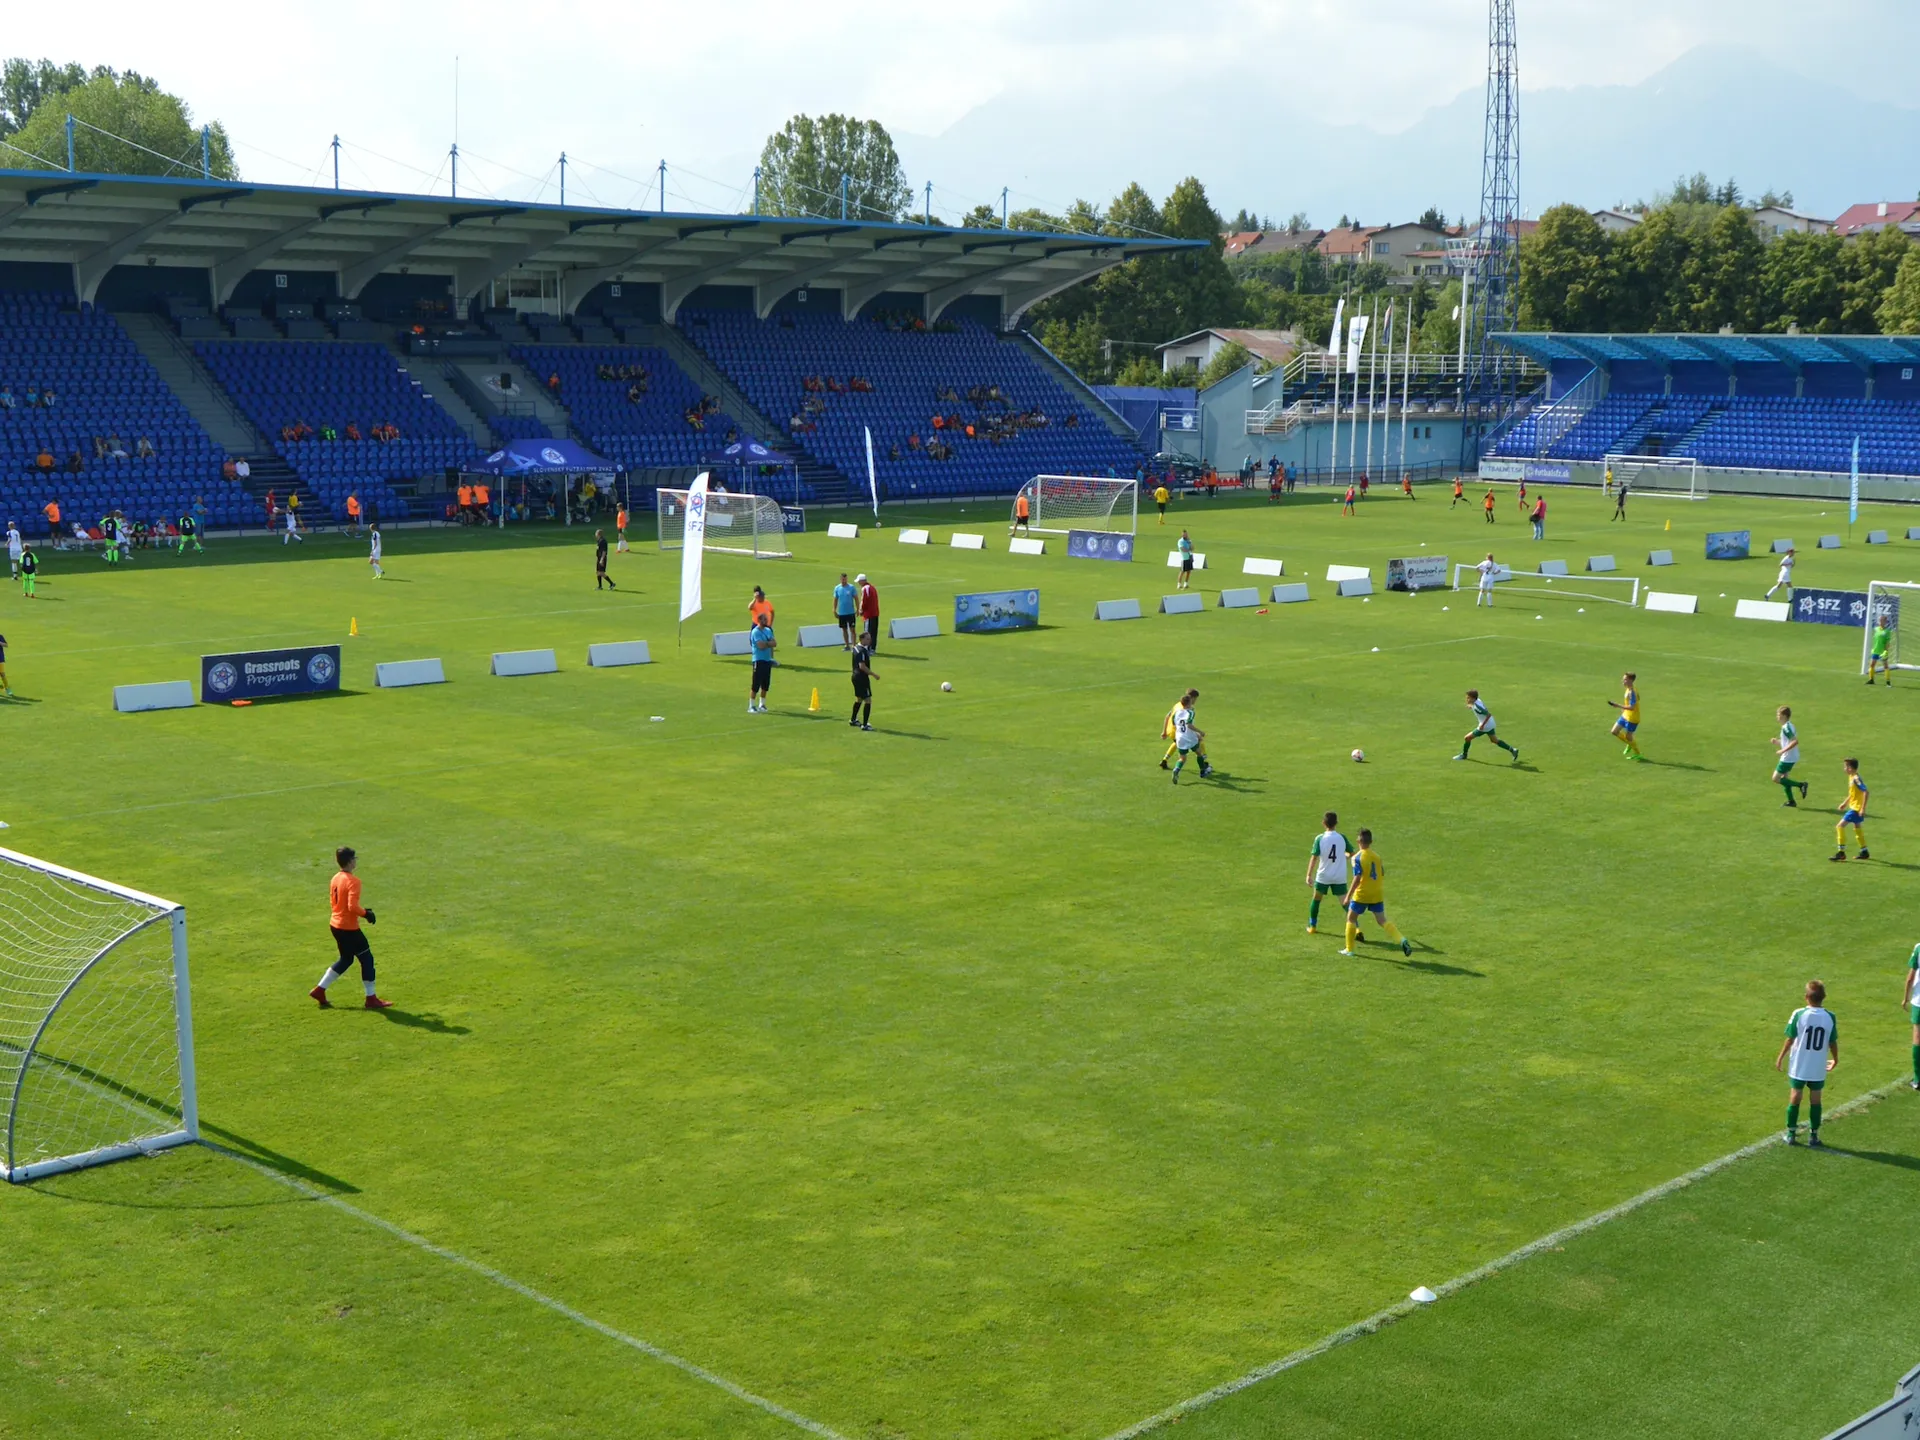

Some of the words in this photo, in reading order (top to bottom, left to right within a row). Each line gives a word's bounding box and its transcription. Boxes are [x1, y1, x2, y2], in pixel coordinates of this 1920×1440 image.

[788, 513, 801, 522] SFZ
[106, 522, 112, 532] 3
[688, 521, 704, 532] SFZ
[1817, 598, 1841, 611] SFZ
[244, 659, 301, 675] Grassroots
[246, 672, 298, 687] Program
[1179, 719, 1187, 733] 3
[1328, 843, 1338, 863] 4
[1369, 861, 1378, 881] 4
[1805, 1025, 1826, 1052] 10
